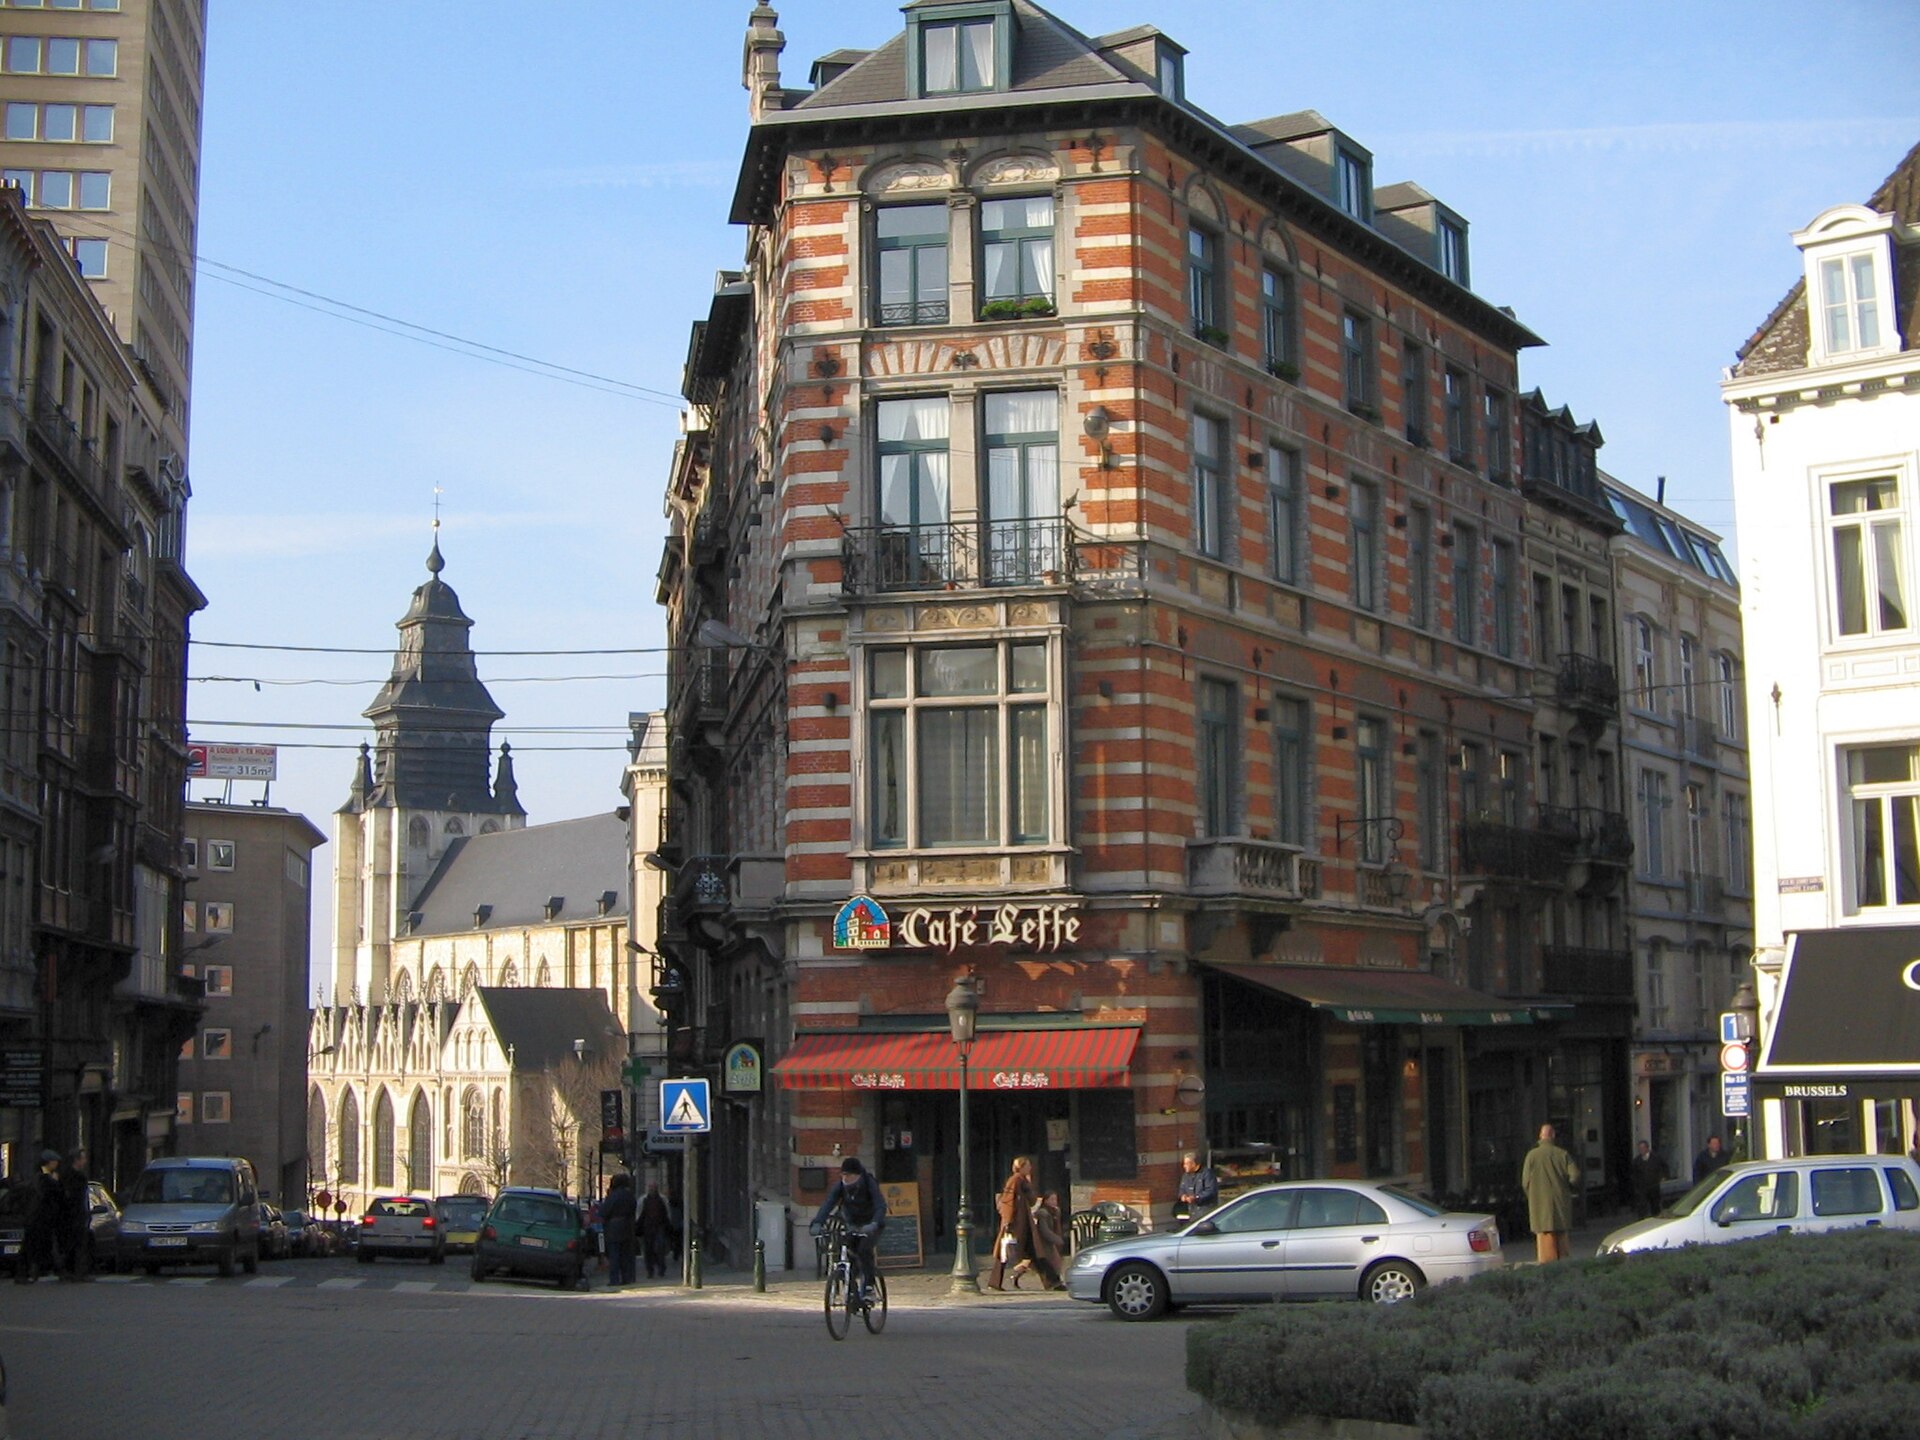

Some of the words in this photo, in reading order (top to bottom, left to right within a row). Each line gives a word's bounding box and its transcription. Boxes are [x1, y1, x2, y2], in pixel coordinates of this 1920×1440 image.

[899, 904, 977, 953] Café
[989, 903, 1081, 952] Leffe
[851, 1073, 877, 1088] Café
[879, 1073, 905, 1088] Leffe
[993, 1071, 1019, 1088] Café
[1021, 1072, 1049, 1088] Leffe
[1784, 1085, 1847, 1097] BRUSSELS
